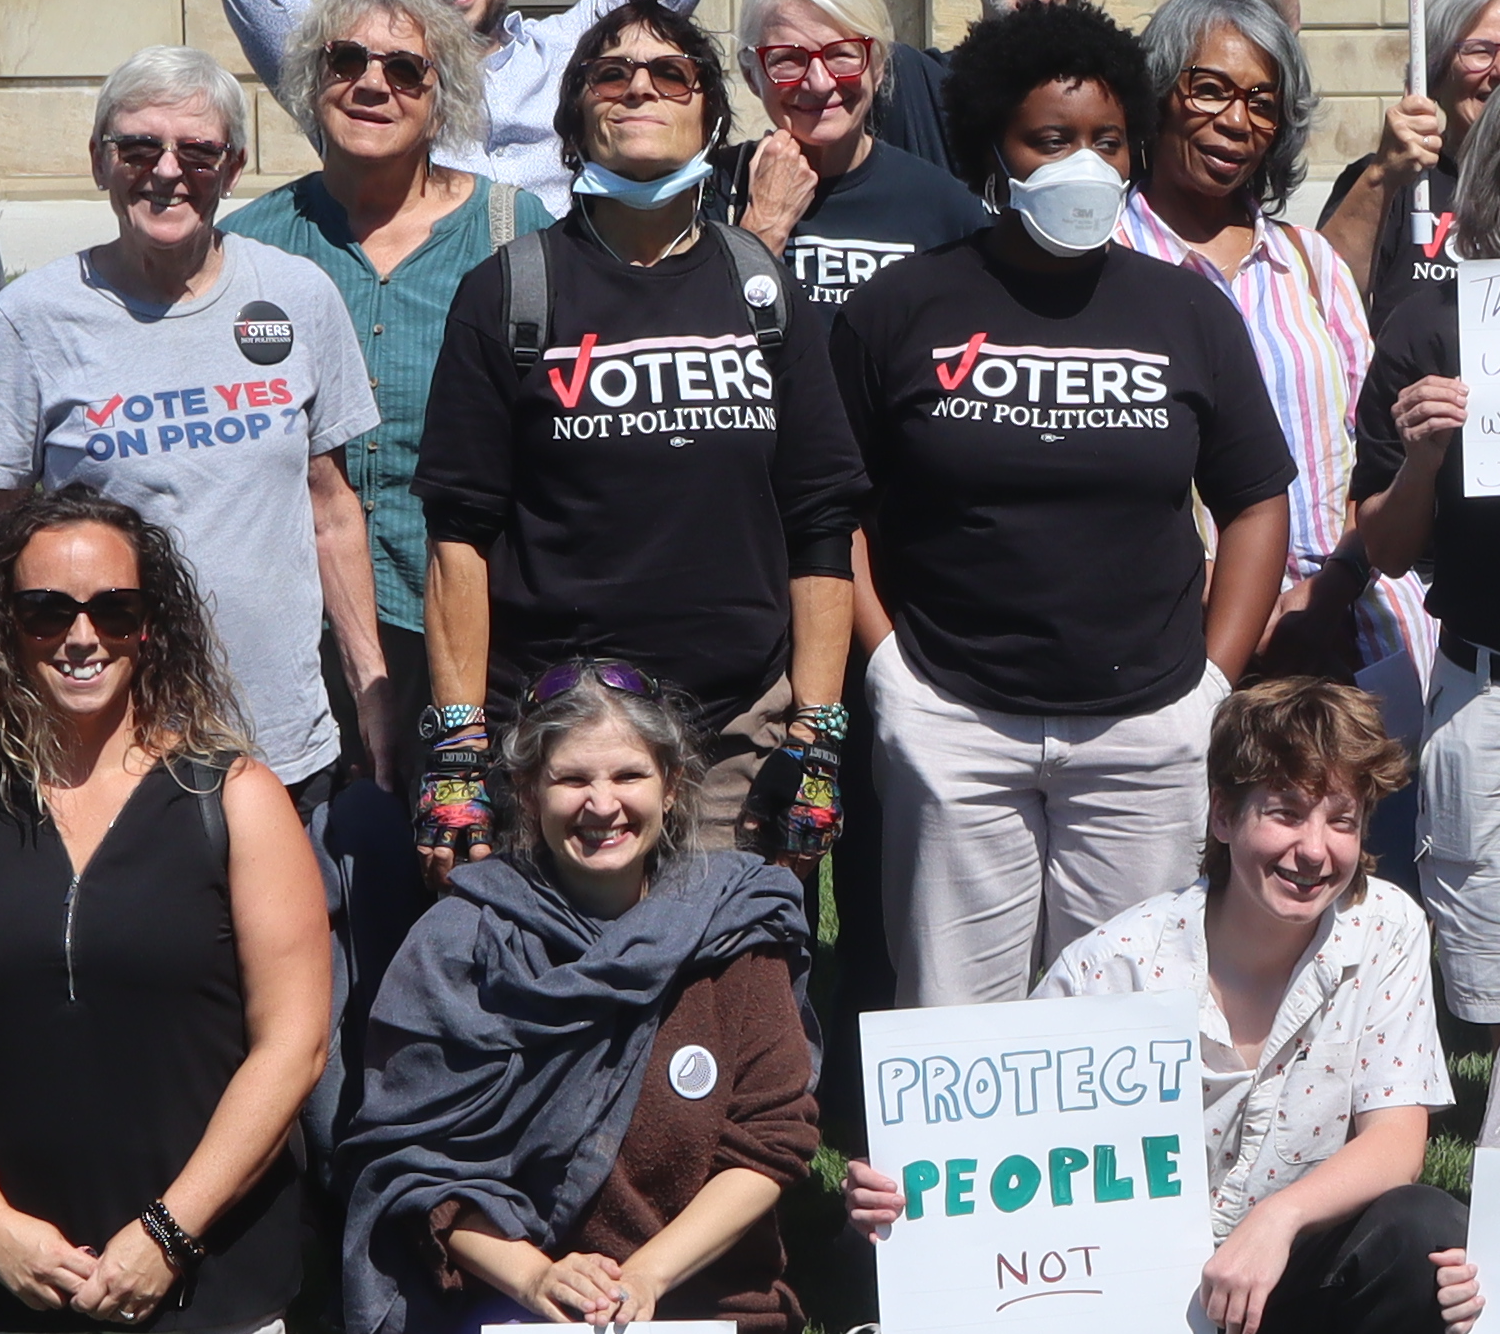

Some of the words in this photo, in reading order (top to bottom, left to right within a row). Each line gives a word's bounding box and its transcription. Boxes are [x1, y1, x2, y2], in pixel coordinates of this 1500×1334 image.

[239, 320, 291, 337] VOTERS
[548, 337, 773, 408] VOTERS
[936, 336, 1168, 405] VOTERS
[213, 378, 294, 412] YES
[932, 397, 988, 419] NOT
[995, 403, 1169, 429] POLITICIANS
[85, 428, 149, 462] ON
[158, 413, 272, 453] PROP
[552, 414, 613, 440] NOT
[619, 406, 777, 436] POLITICIANS
[877, 1039, 1192, 1126] PROTECT
[902, 1133, 1183, 1221] PEOPLE
[996, 1246, 1100, 1290] NOT
